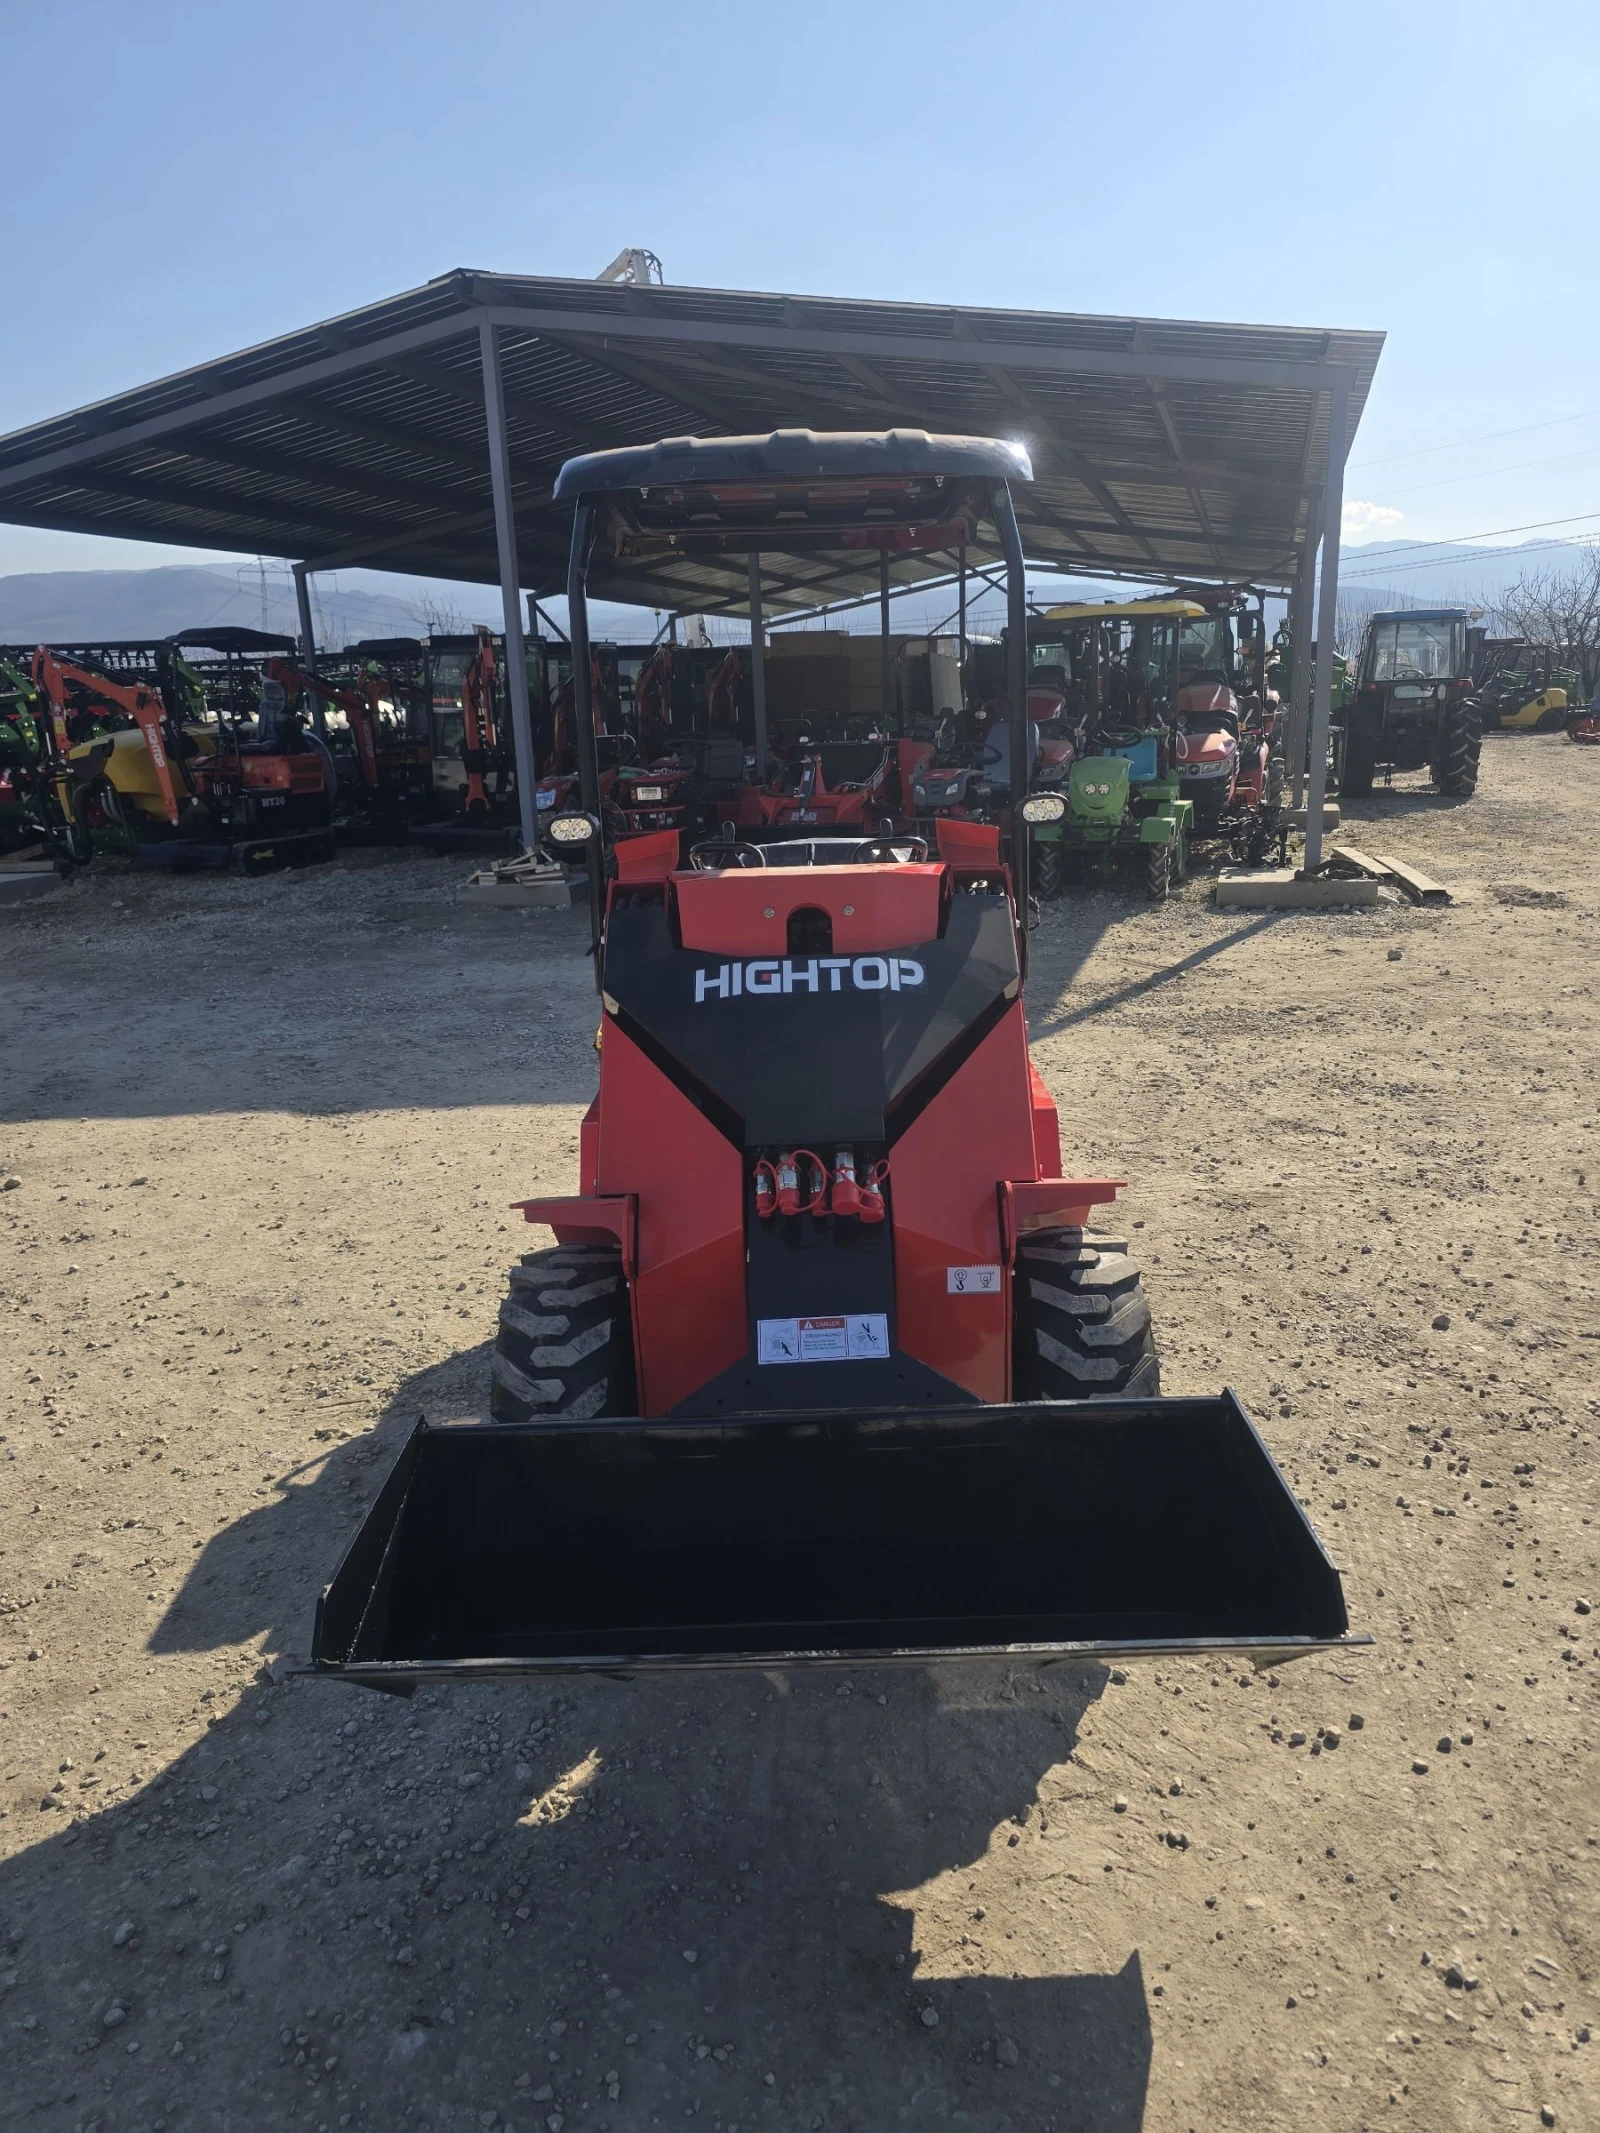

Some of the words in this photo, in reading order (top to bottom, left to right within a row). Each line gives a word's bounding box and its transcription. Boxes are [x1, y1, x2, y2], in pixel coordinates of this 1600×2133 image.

[145, 724, 165, 767] HIGHTOP
[262, 797, 285, 807] HT20
[695, 957, 924, 1002] HIGHTOP
[815, 1320, 840, 1328] DANGER
